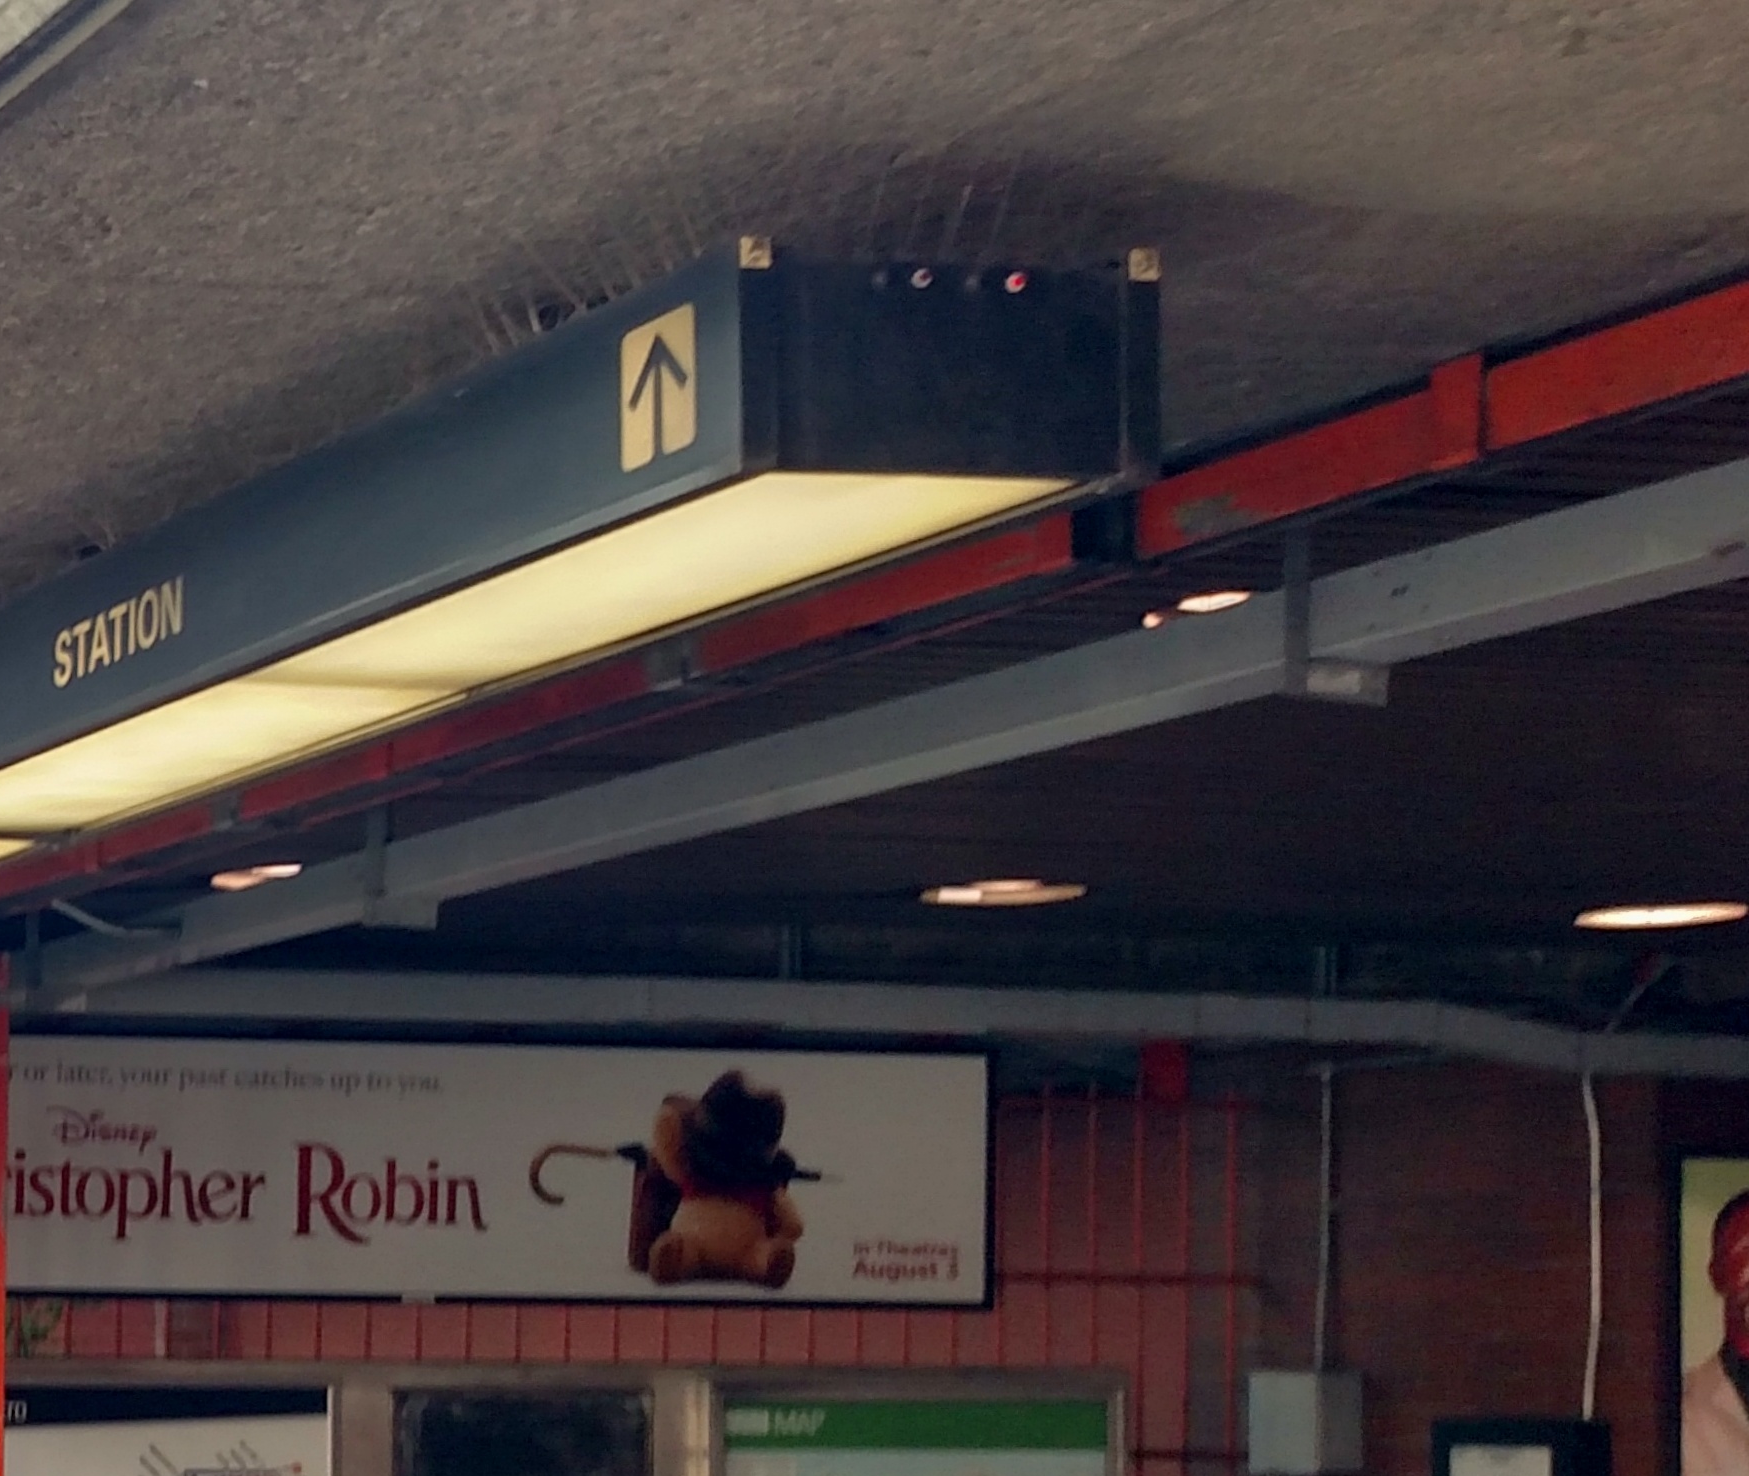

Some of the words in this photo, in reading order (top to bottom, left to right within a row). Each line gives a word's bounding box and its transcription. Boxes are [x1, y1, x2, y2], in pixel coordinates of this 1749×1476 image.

[53, 574, 185, 688] STATION
[119, 1065, 171, 1092] your
[330, 1072, 361, 1097] up
[47, 1104, 158, 1157] Disney
[5, 1147, 267, 1241] istopher
[295, 1140, 489, 1245] Robin
[853, 1261, 939, 1282] August
